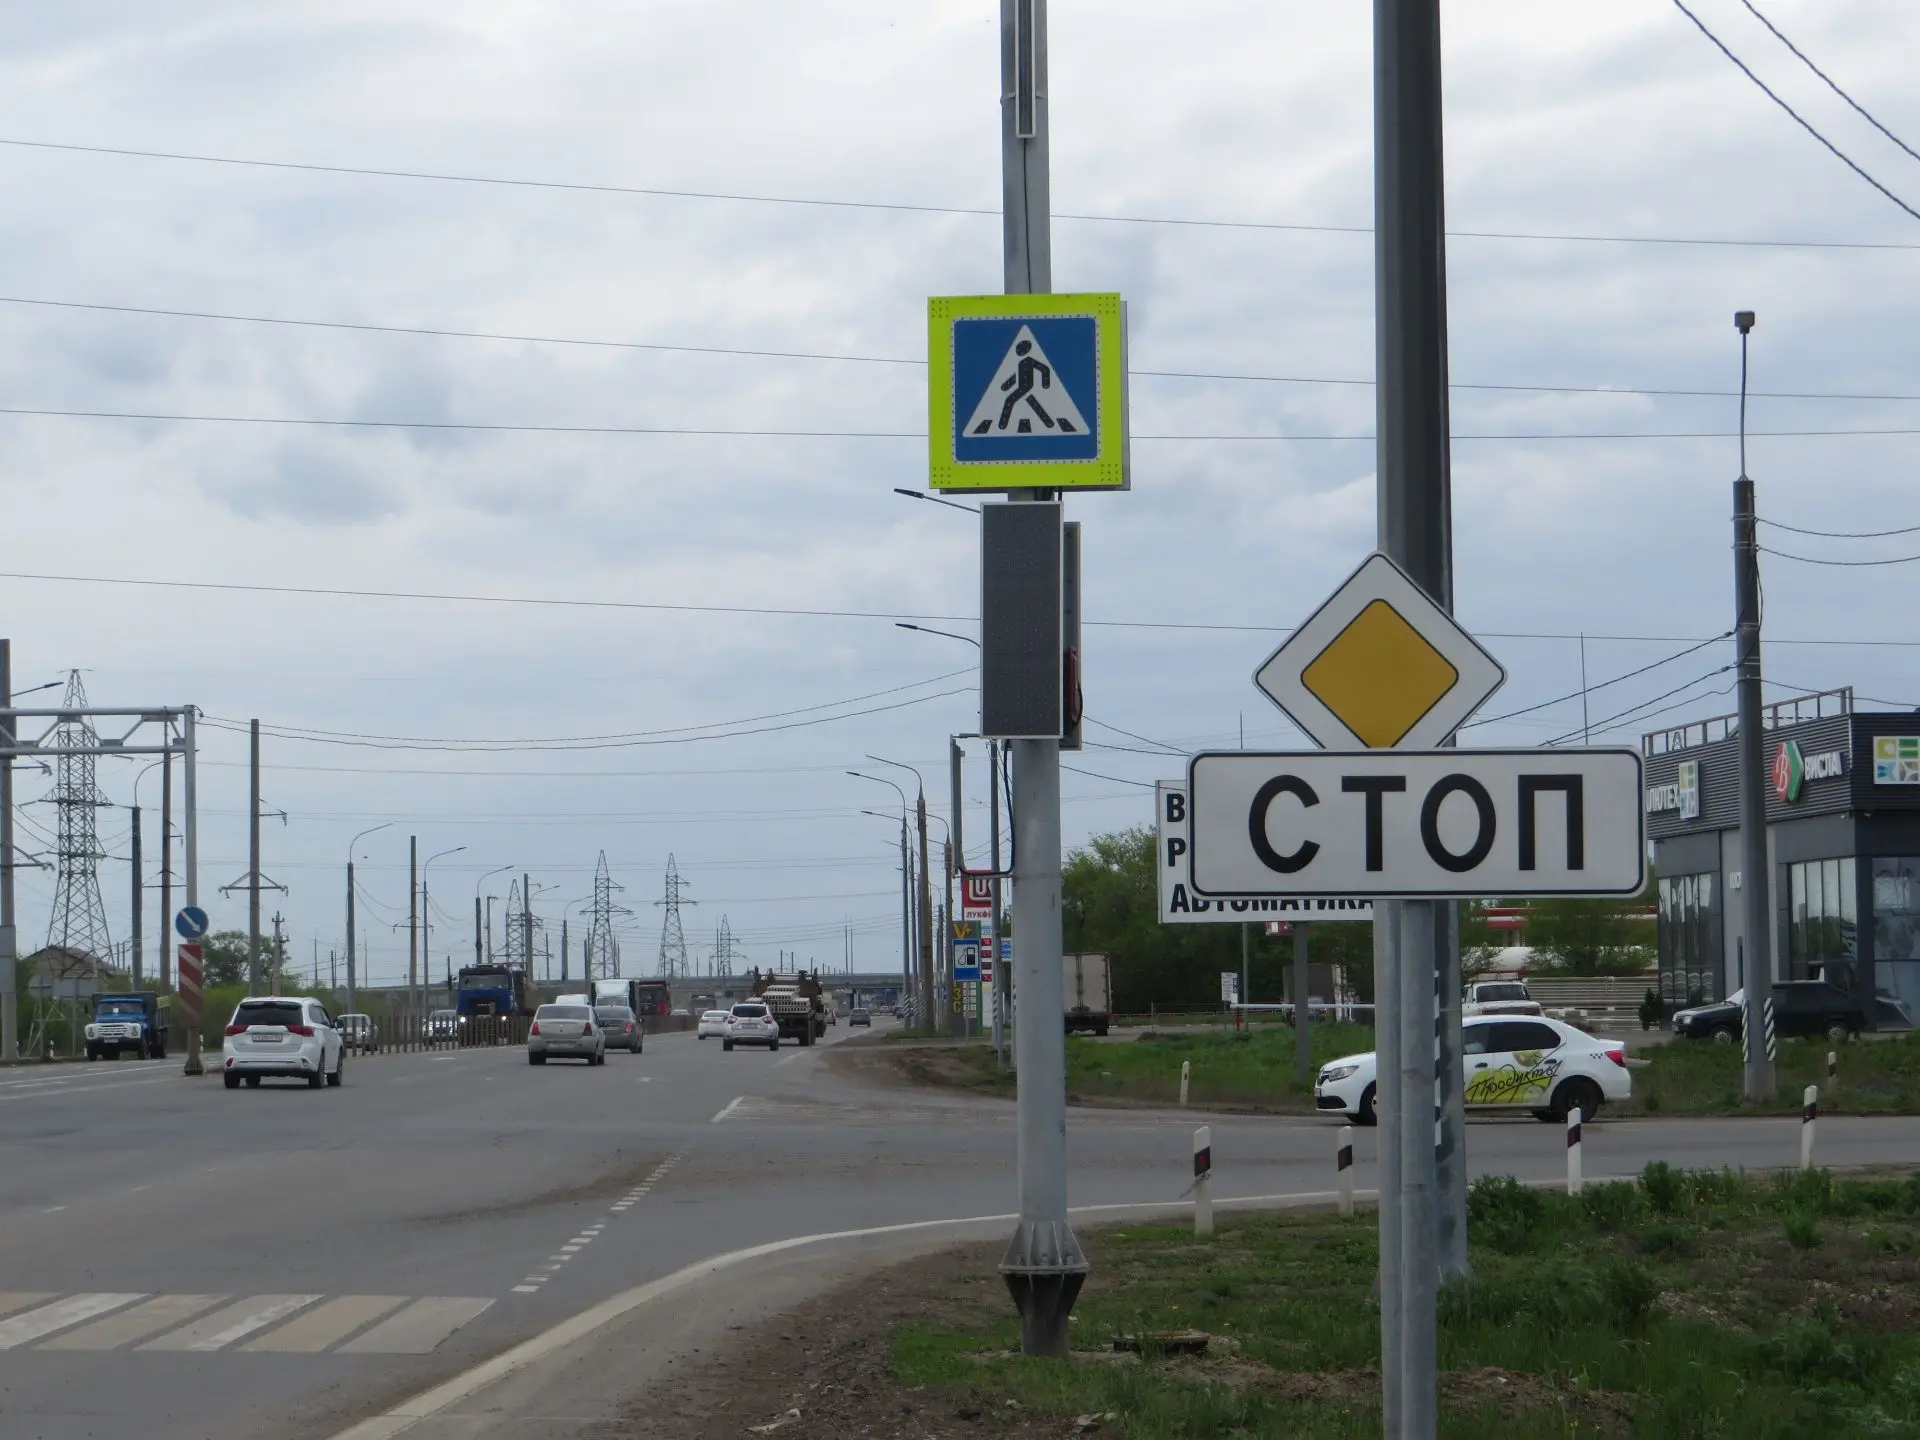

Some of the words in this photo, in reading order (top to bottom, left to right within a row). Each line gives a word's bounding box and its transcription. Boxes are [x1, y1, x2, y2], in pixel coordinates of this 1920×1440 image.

[1804, 752, 1842, 780] ВИСЛА
[1248, 773, 1584, 873] СТОП
[1464, 1055, 1564, 1104] Продукты
